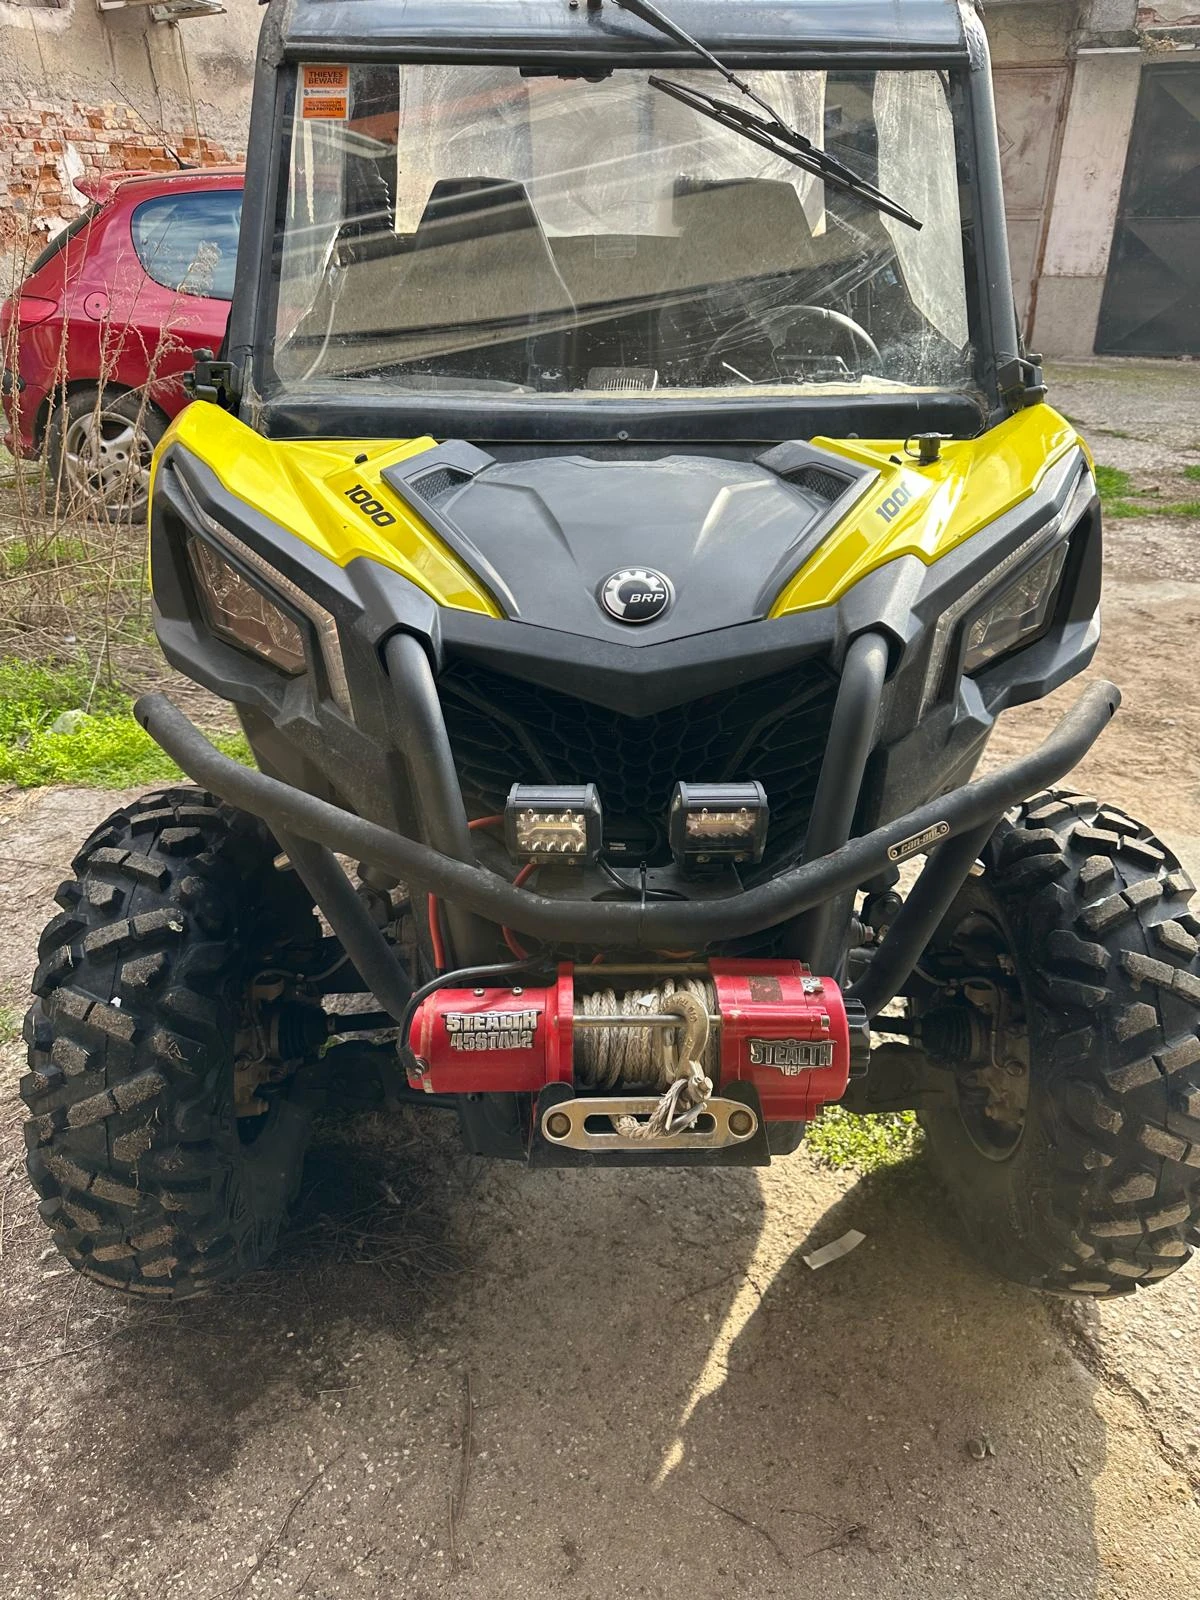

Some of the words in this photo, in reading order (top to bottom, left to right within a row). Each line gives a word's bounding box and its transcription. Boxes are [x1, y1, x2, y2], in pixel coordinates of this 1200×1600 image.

[308, 77, 343, 85] BEWARE
[344, 484, 397, 527] 1000
[629, 593, 665, 604] BRP
[446, 1012, 537, 1032] STEALTH
[750, 1042, 833, 1067] STEALTH
[784, 1064, 798, 1076] V2
